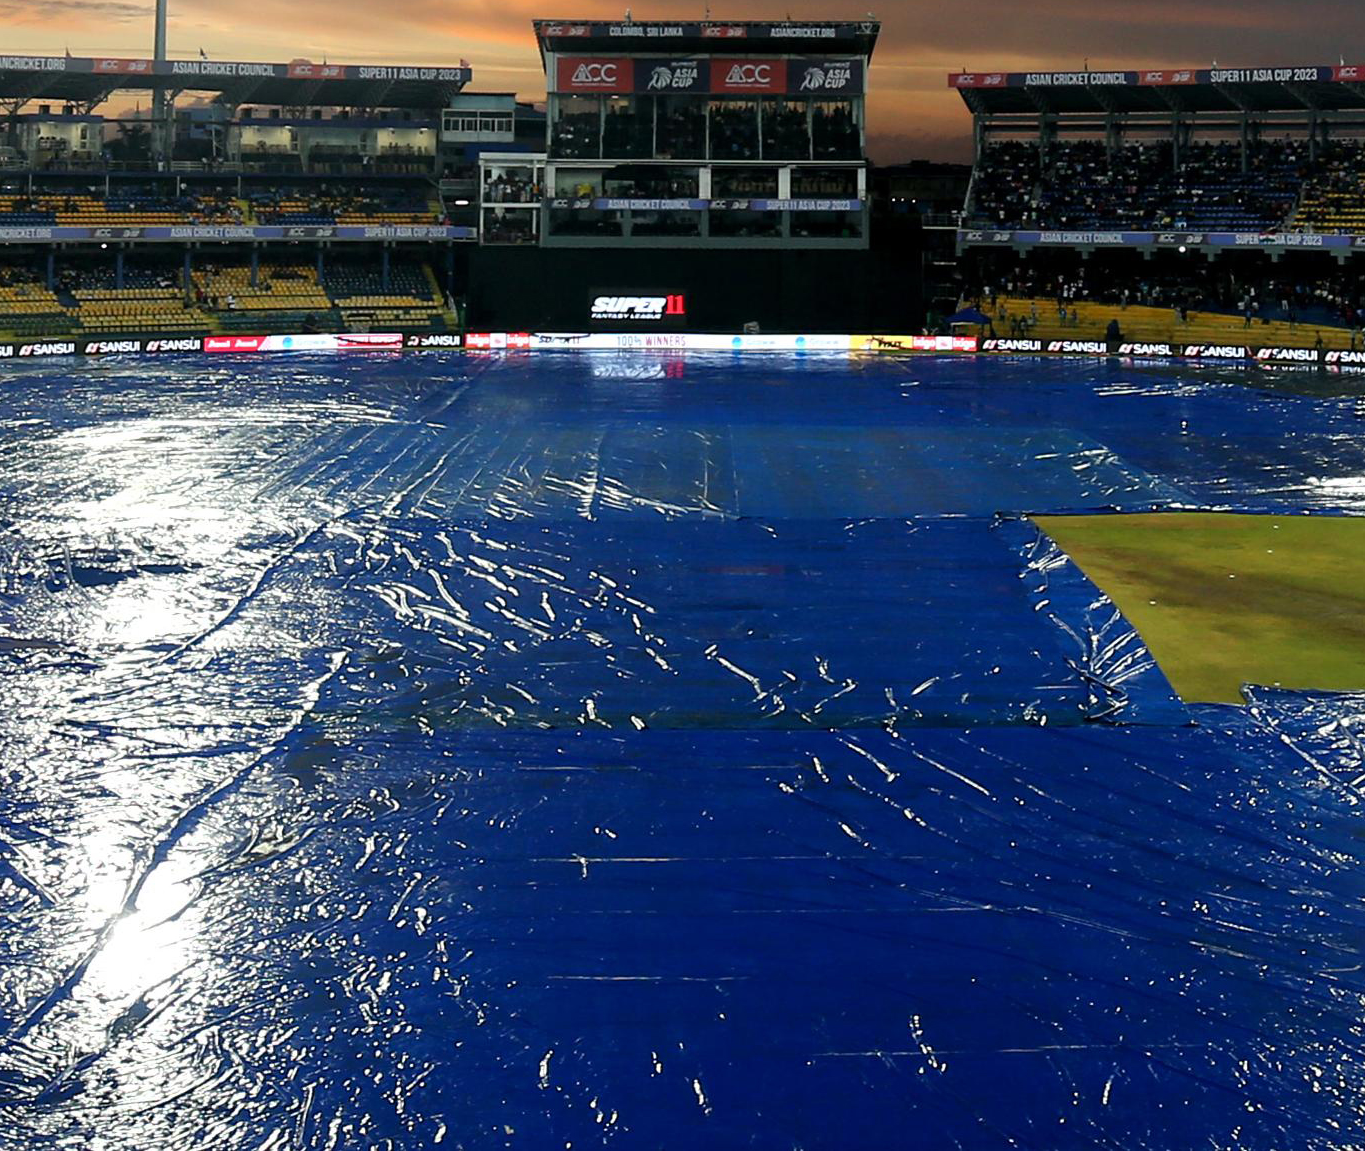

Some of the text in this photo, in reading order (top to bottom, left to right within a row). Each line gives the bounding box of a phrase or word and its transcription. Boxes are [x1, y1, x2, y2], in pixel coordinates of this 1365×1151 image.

[660, 27, 683, 37] LANKA
[172, 61, 275, 77] ASIAN CRICKET COUNCIL
[399, 68, 419, 80] ASIA
[420, 68, 436, 80] CUP
[438, 69, 461, 81] 2023
[571, 63, 617, 82] ACC
[674, 68, 698, 78] ASIA
[725, 64, 771, 83] ACC
[826, 68, 851, 79] ASIA
[1252, 69, 1274, 81] ASIA
[1275, 69, 1293, 81] CUP
[1294, 68, 1318, 81] 2023
[672, 77, 693, 88] CUP
[824, 77, 846, 89] CUP
[1025, 73, 1127, 85] ASIAN CRICKET COUNCIL
[608, 199, 691, 210] ASIAN CRICKET COUNCIL
[798, 200, 816, 210] ASIA
[818, 200, 831, 210] CUP
[832, 200, 851, 211] 2023
[1040, 232, 1123, 243] ASIAN CRICKET COUNCIL
[1286, 235, 1322, 246] CUP 2023
[99, 341, 140, 353] SANSUI
[645, 336, 686, 346] WINNERS
[997, 339, 1041, 351] SANSUI
[32, 343, 75, 356] SANSUI
[1062, 341, 1107, 354] SANSUI
